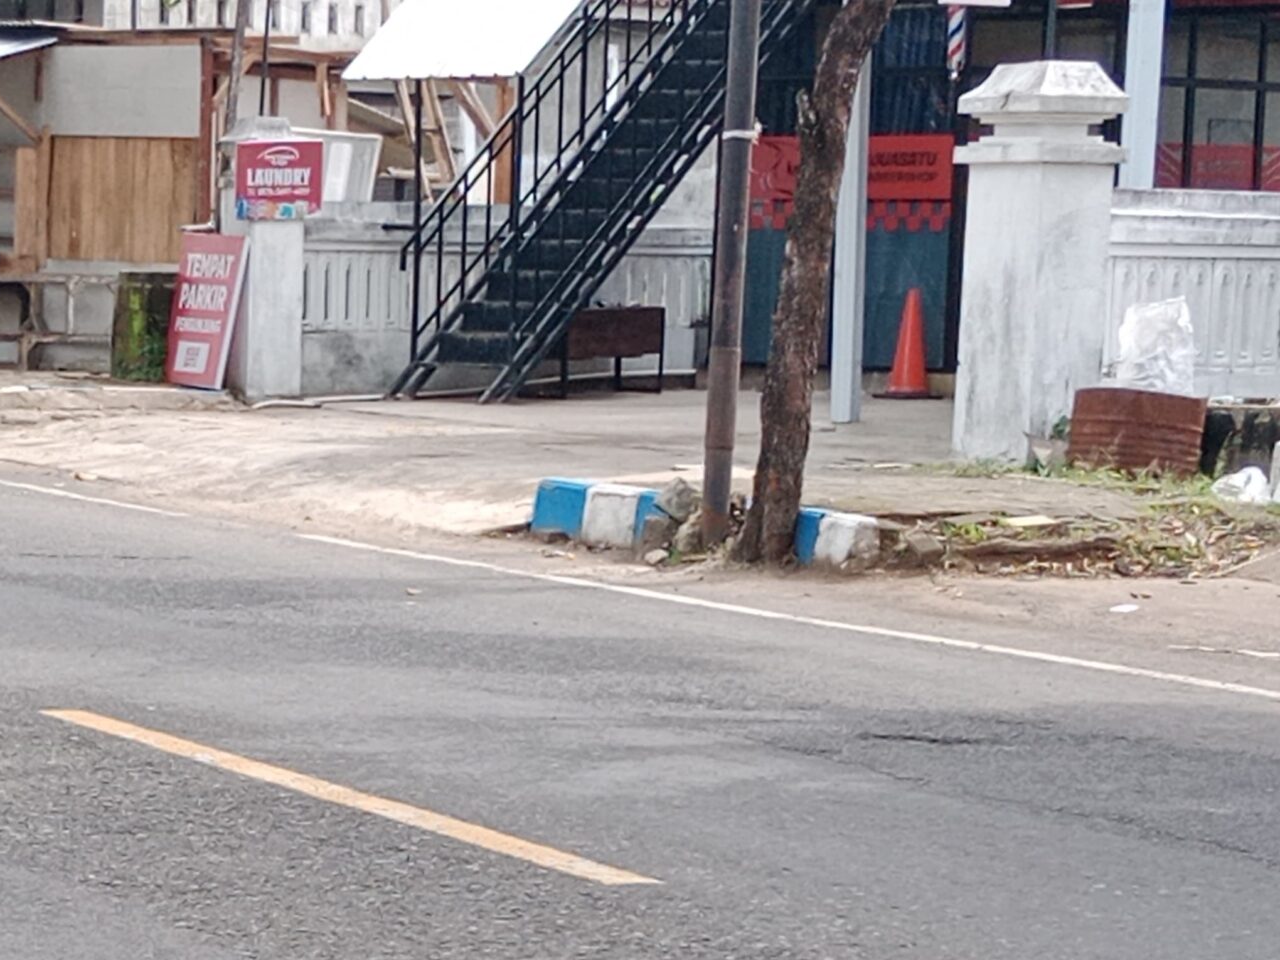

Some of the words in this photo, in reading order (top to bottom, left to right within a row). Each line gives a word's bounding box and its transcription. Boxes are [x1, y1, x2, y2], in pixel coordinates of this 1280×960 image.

[246, 167, 311, 187] LAUNDRY
[186, 252, 235, 279] TEMPAT
[178, 282, 228, 312] PARKIR
